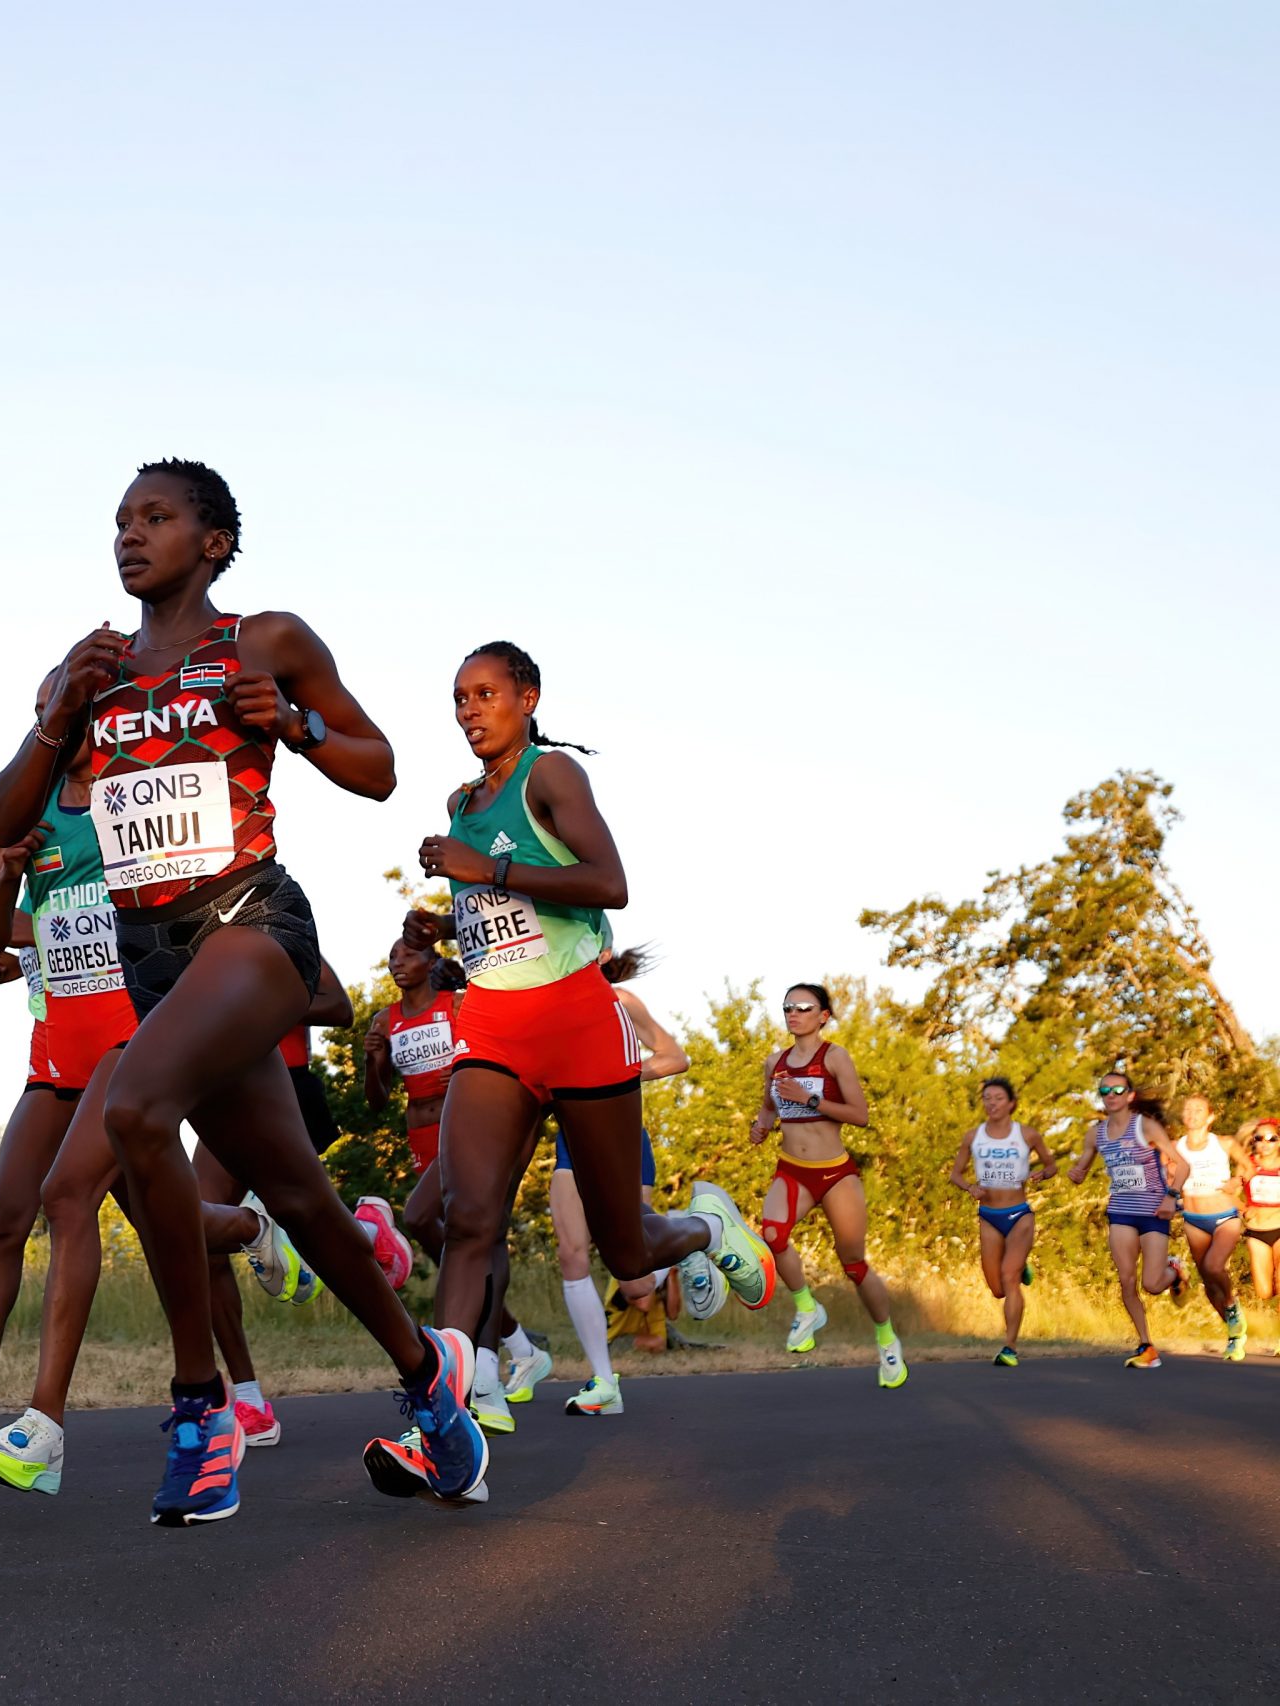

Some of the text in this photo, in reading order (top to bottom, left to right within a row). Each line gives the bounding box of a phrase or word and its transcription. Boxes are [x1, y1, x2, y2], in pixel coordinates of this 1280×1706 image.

[94, 698, 218, 747] KENYA
[132, 773, 202, 805] QNB
[113, 811, 201, 856] TANUI
[489, 842, 518, 857] adidas
[120, 858, 207, 886] OREGON22
[465, 887, 511, 915] QNB
[465, 946, 528, 976] OREGON22
[411, 1026, 440, 1042] QNB
[395, 1040, 451, 1065] GESABWA
[978, 1147, 1020, 1159] USA
[983, 1170, 1016, 1181] BATES
